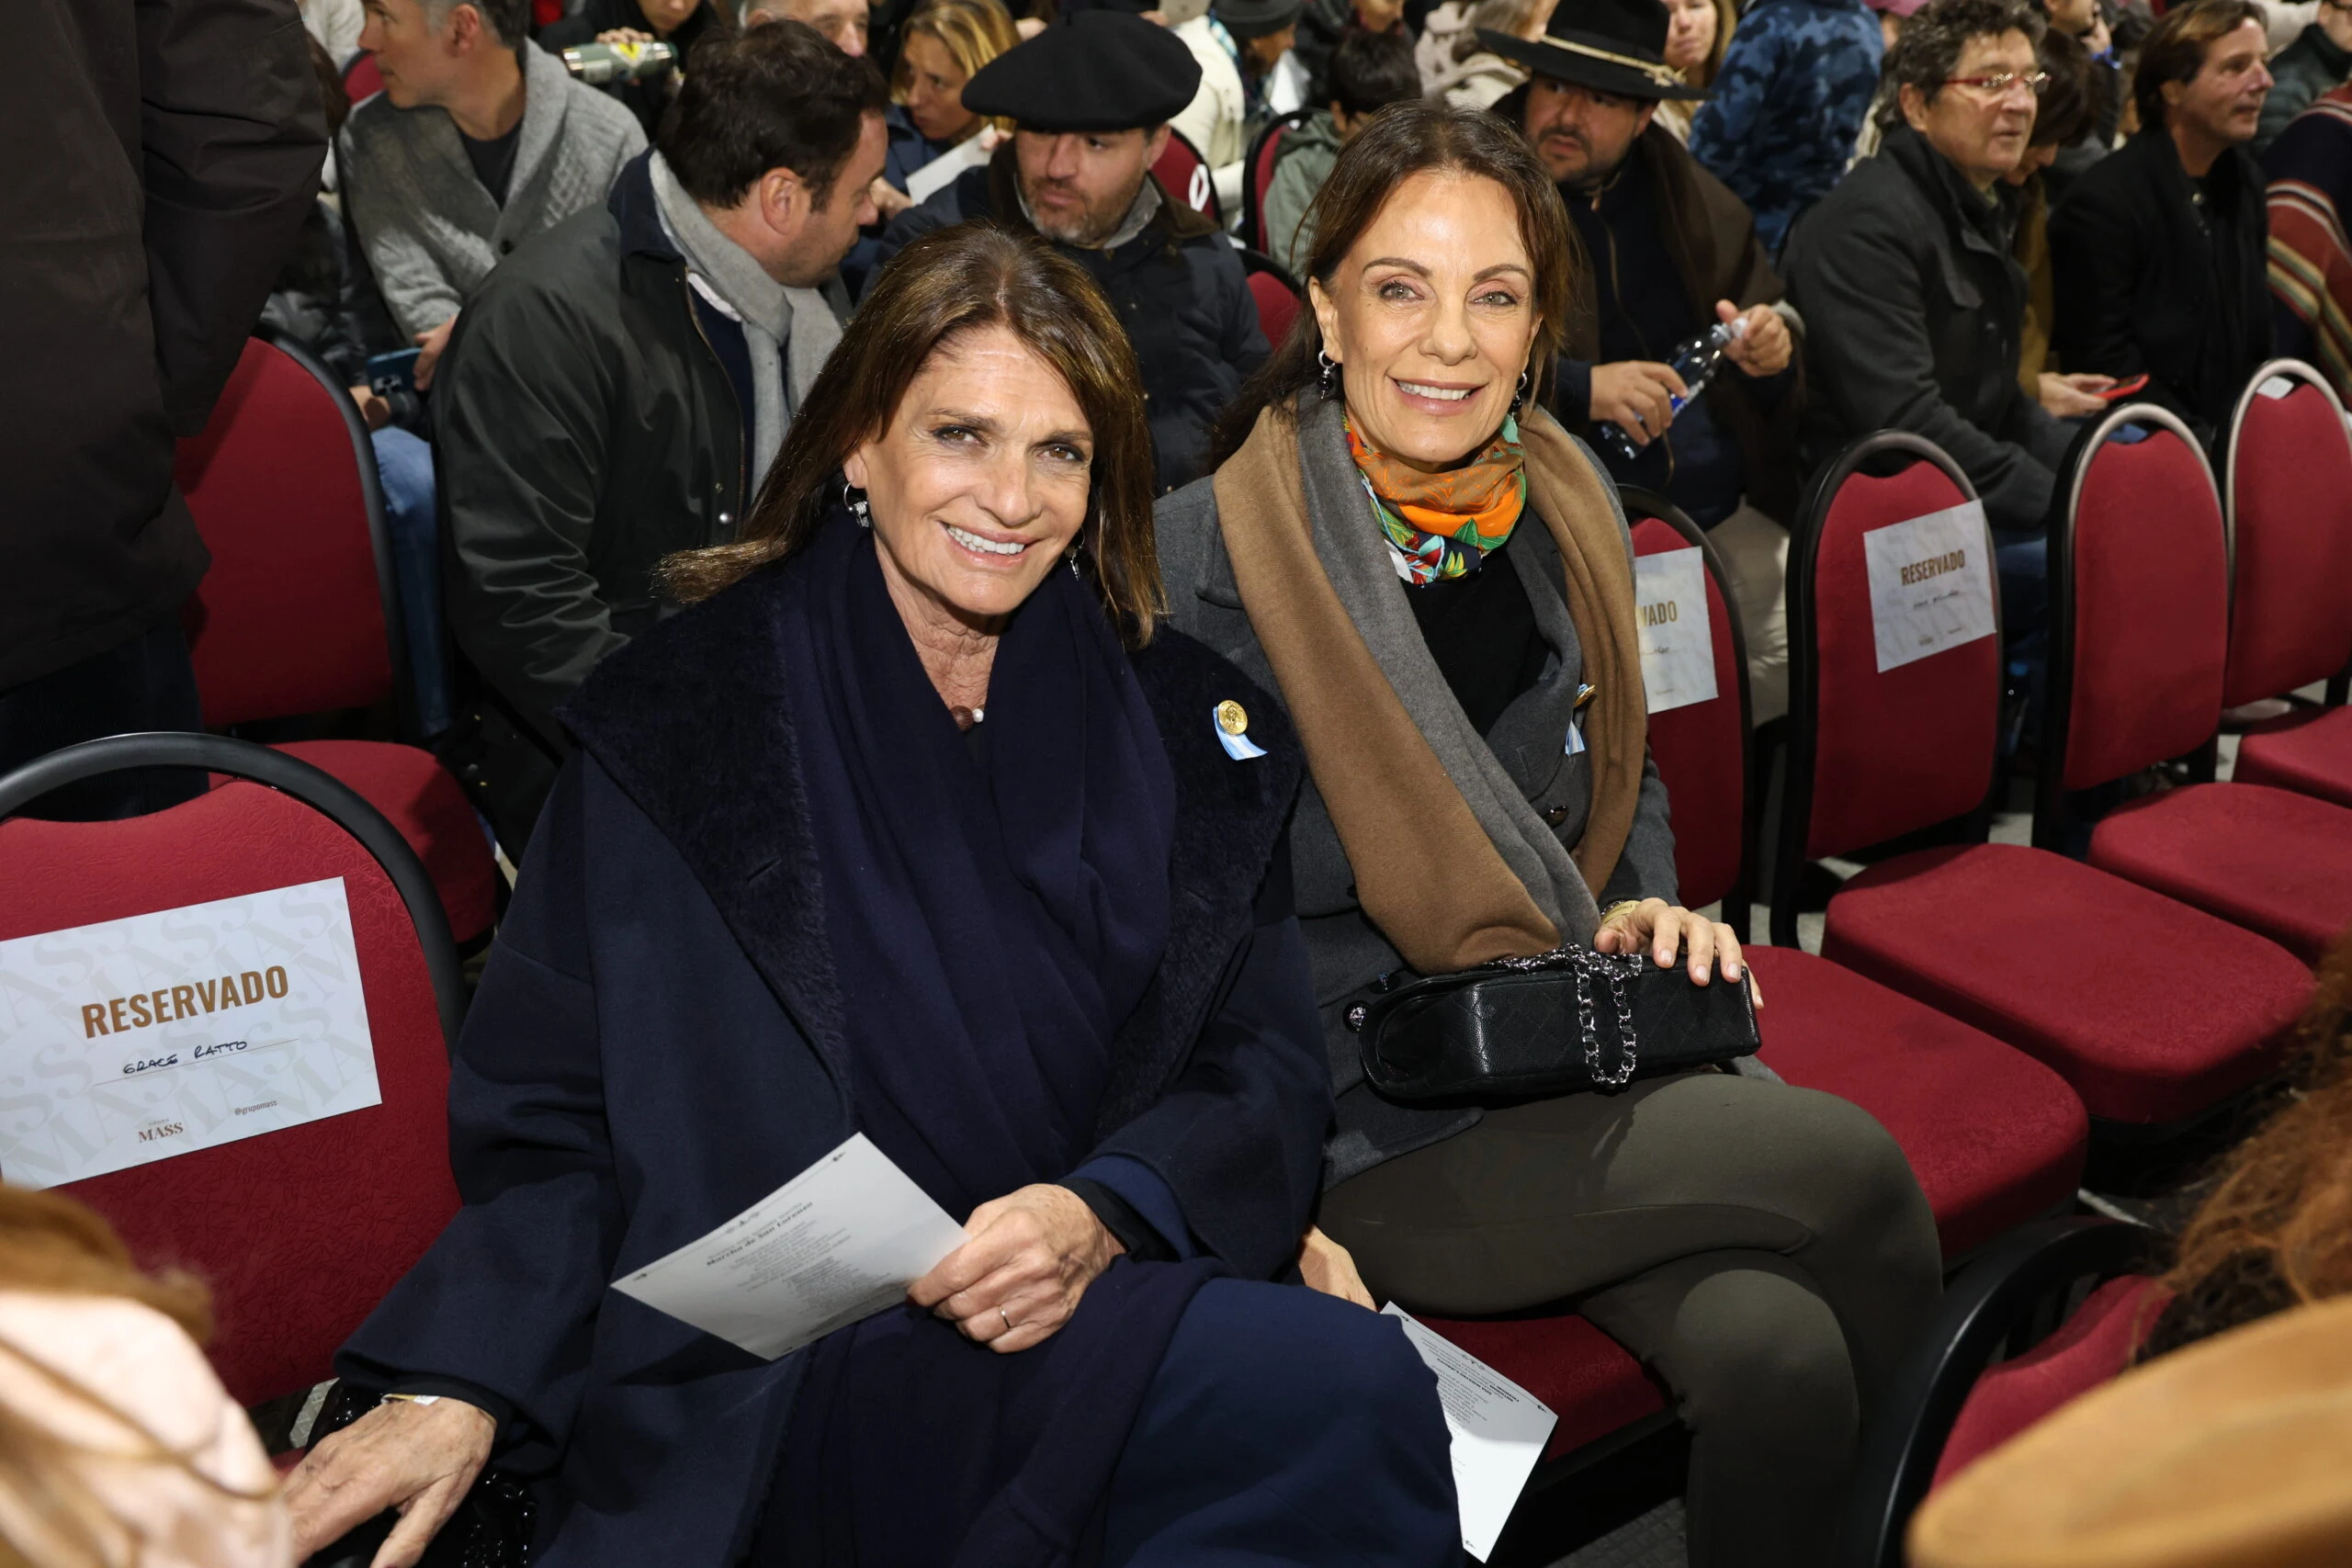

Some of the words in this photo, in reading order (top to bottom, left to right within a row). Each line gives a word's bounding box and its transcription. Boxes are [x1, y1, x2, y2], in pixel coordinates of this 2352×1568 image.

[1901, 549, 1965, 585] RESERVADO
[1636, 600, 1678, 626] VADO
[82, 965, 289, 1039] RESERVADO
[194, 1041, 247, 1059] RATTO
[234, 1100, 277, 1116] @grupomass
[138, 1122, 184, 1144] MASS
